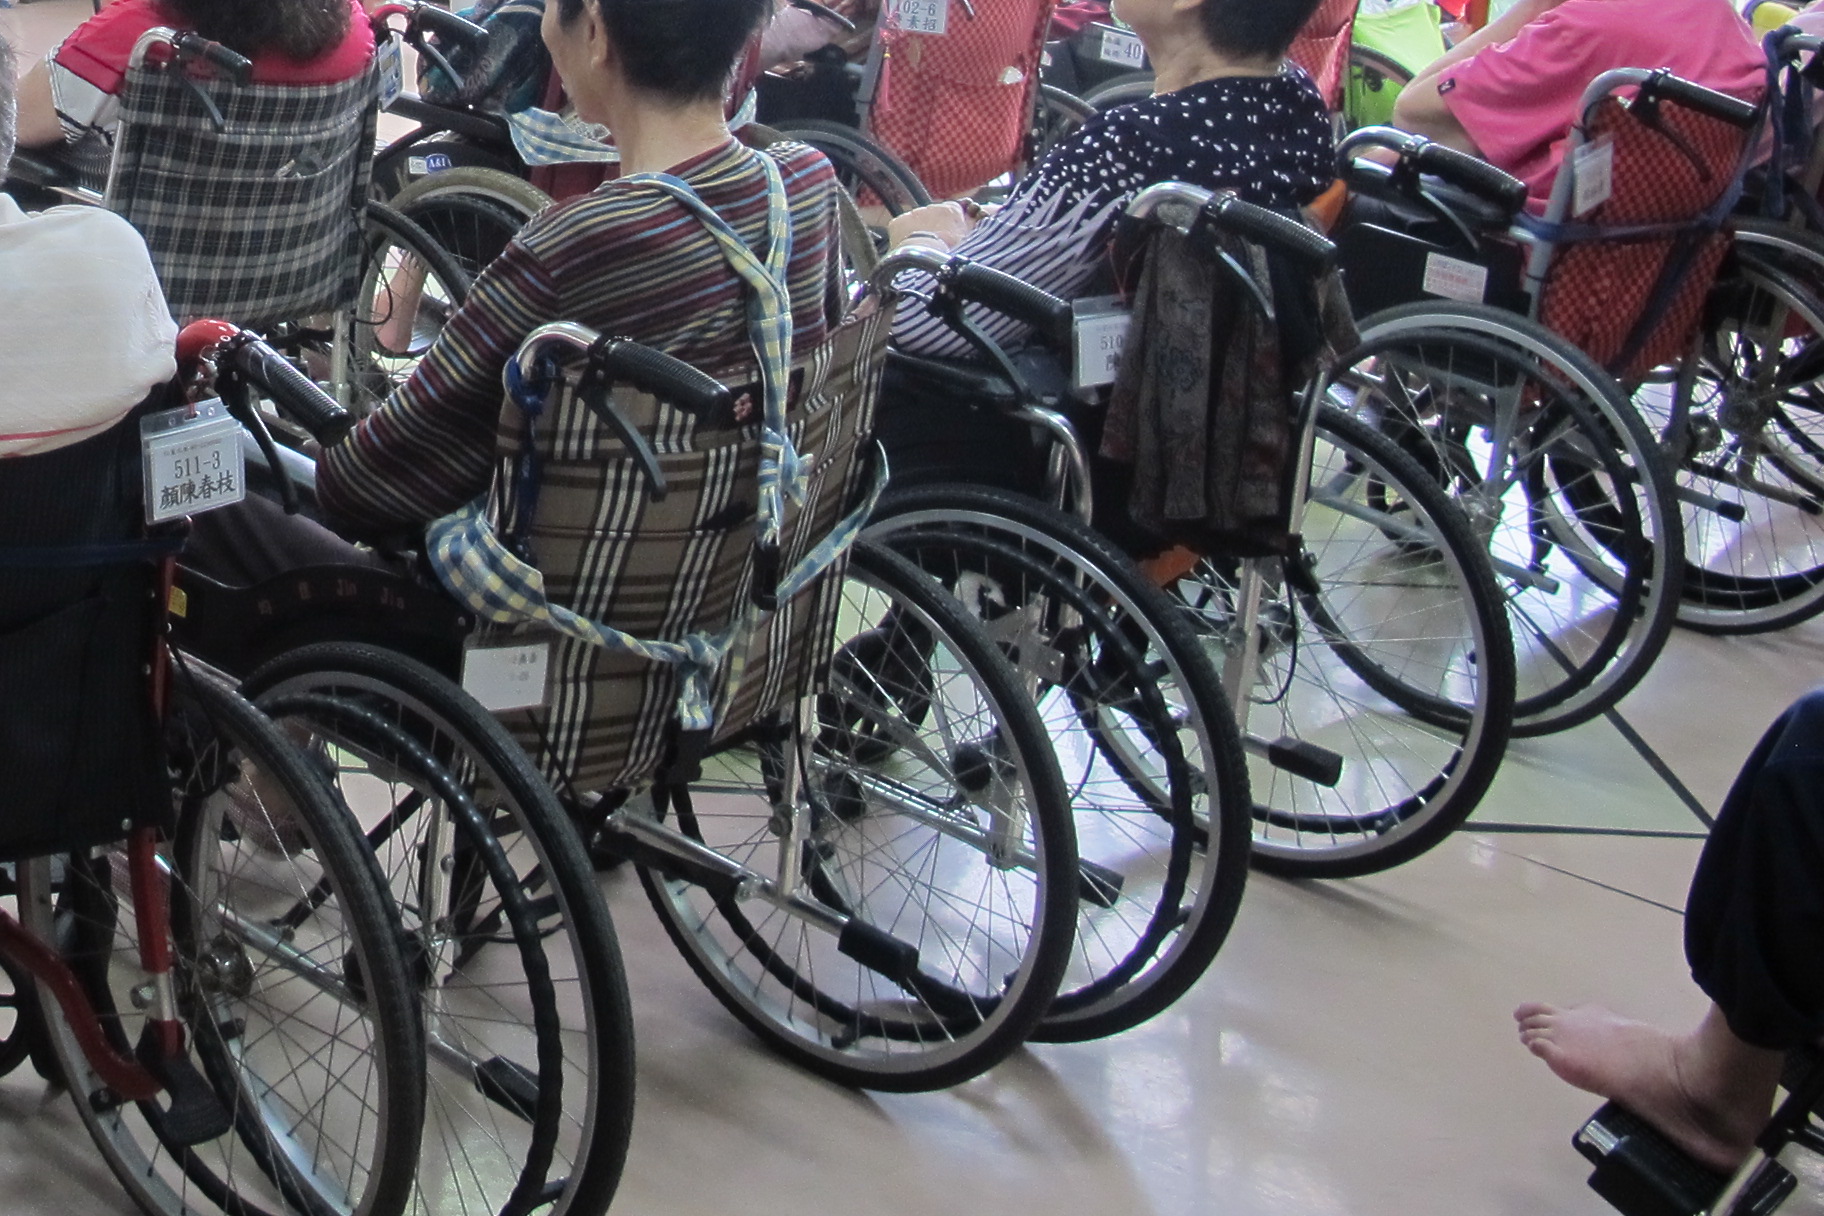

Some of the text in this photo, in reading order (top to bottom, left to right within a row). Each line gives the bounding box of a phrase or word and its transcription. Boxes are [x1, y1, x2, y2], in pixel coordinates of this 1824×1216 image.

[895, 0, 936, 16] 02-6
[1124, 42, 1142, 60] 40
[174, 451, 221, 479] 511-3
[160, 470, 236, 510] 顏陳春枝
